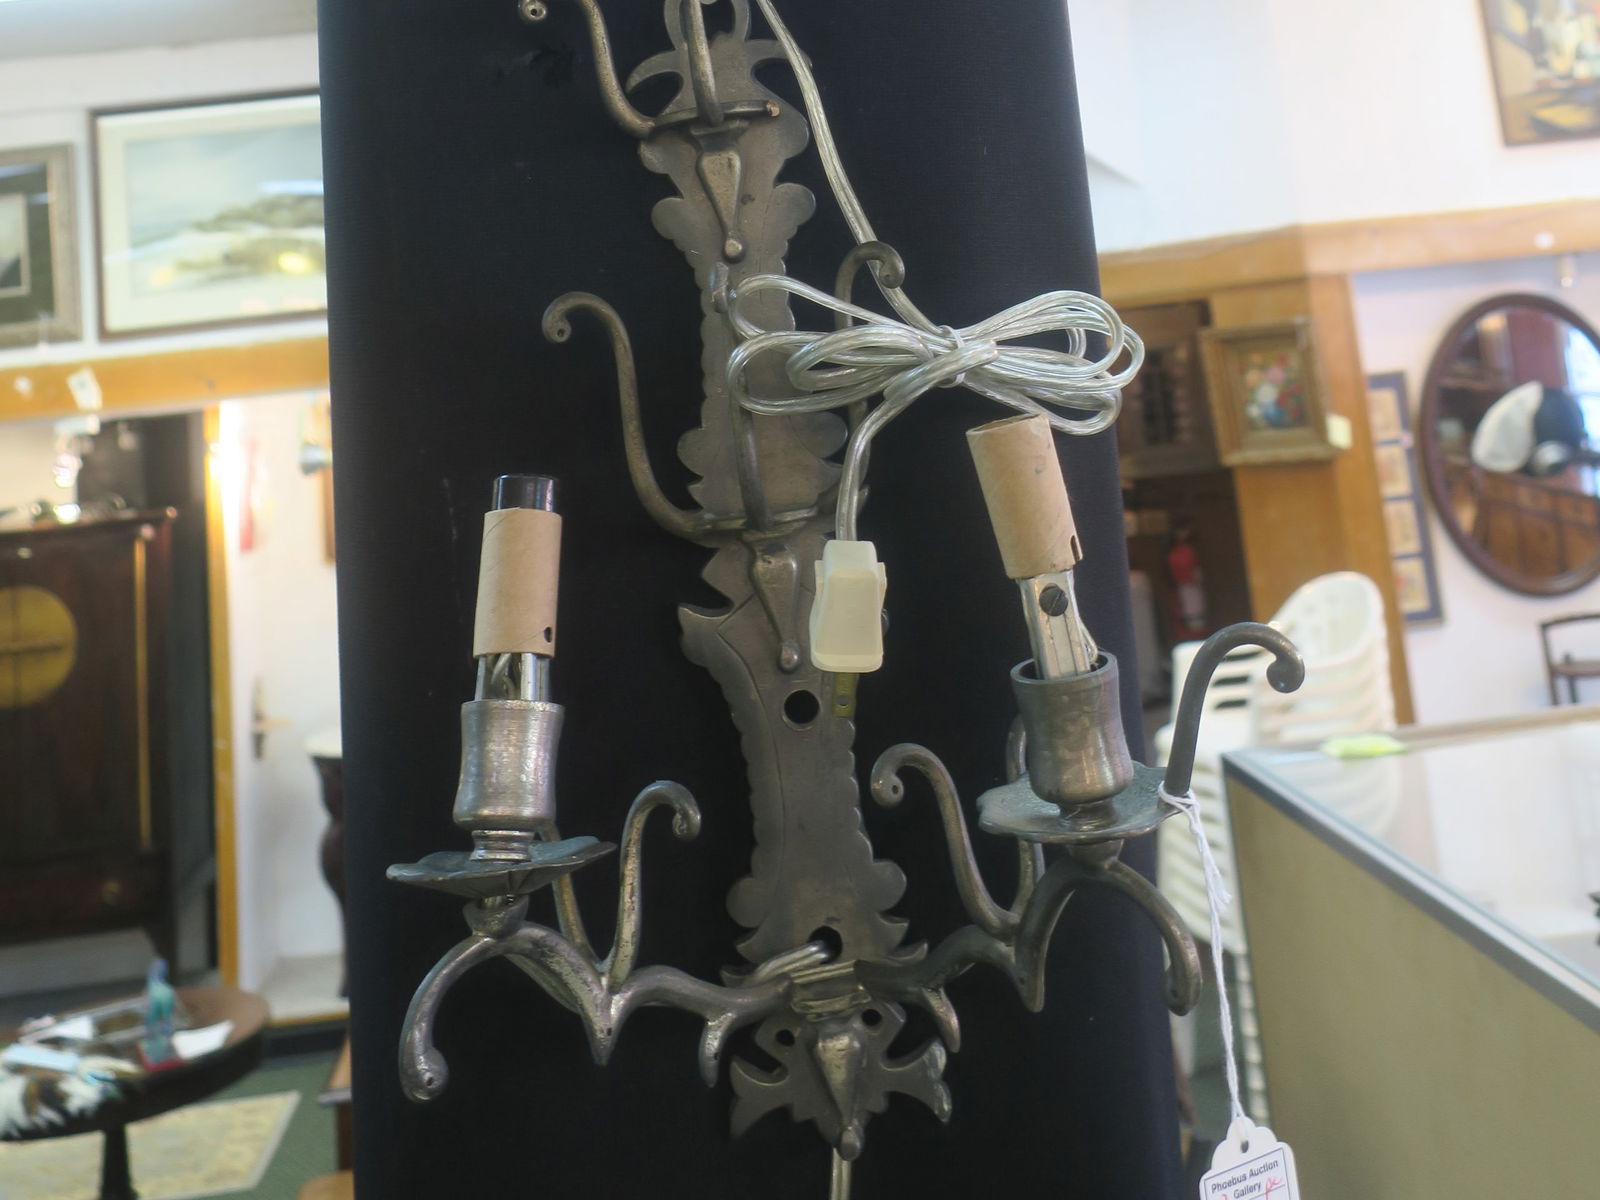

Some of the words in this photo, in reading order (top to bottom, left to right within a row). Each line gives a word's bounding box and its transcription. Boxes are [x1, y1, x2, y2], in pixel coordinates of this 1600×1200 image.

[1211, 1173, 1247, 1193] Phoebus
[1249, 1160, 1279, 1178] Auction
[1233, 1182, 1261, 1199] Gallery
